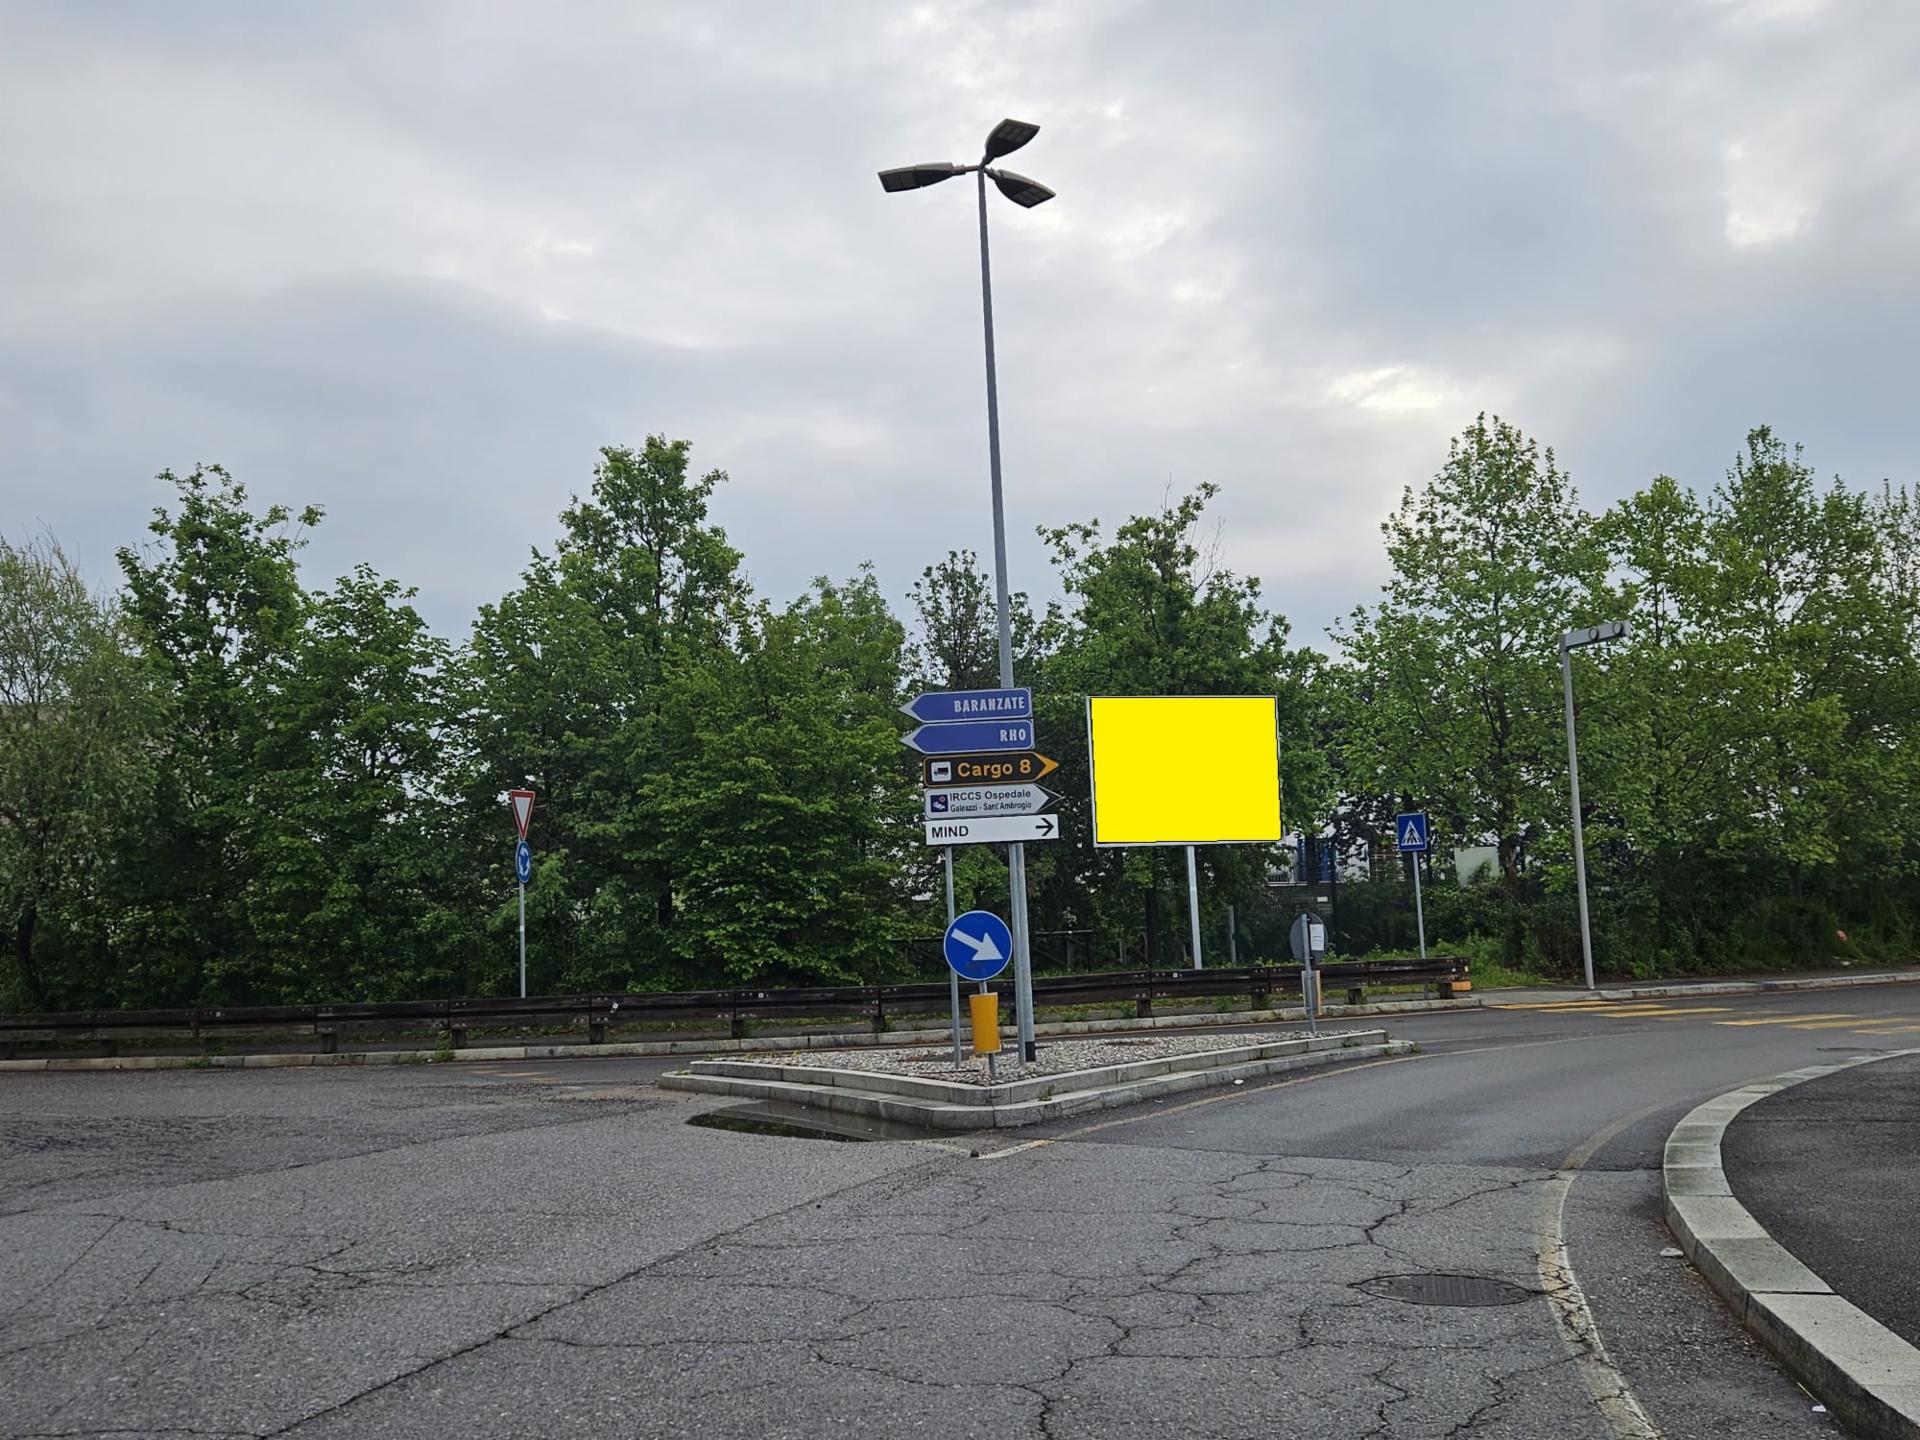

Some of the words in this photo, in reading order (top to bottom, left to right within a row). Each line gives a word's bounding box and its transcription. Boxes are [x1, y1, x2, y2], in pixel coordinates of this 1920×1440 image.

[954, 697, 1025, 712] BARANZATE
[1000, 729, 1026, 741] RHO
[958, 762, 1012, 777] Cargo
[1020, 759, 1031, 773] 8
[950, 791, 981, 801] IRCCS
[985, 790, 1031, 801] Ospedale
[932, 826, 968, 838] MIND
